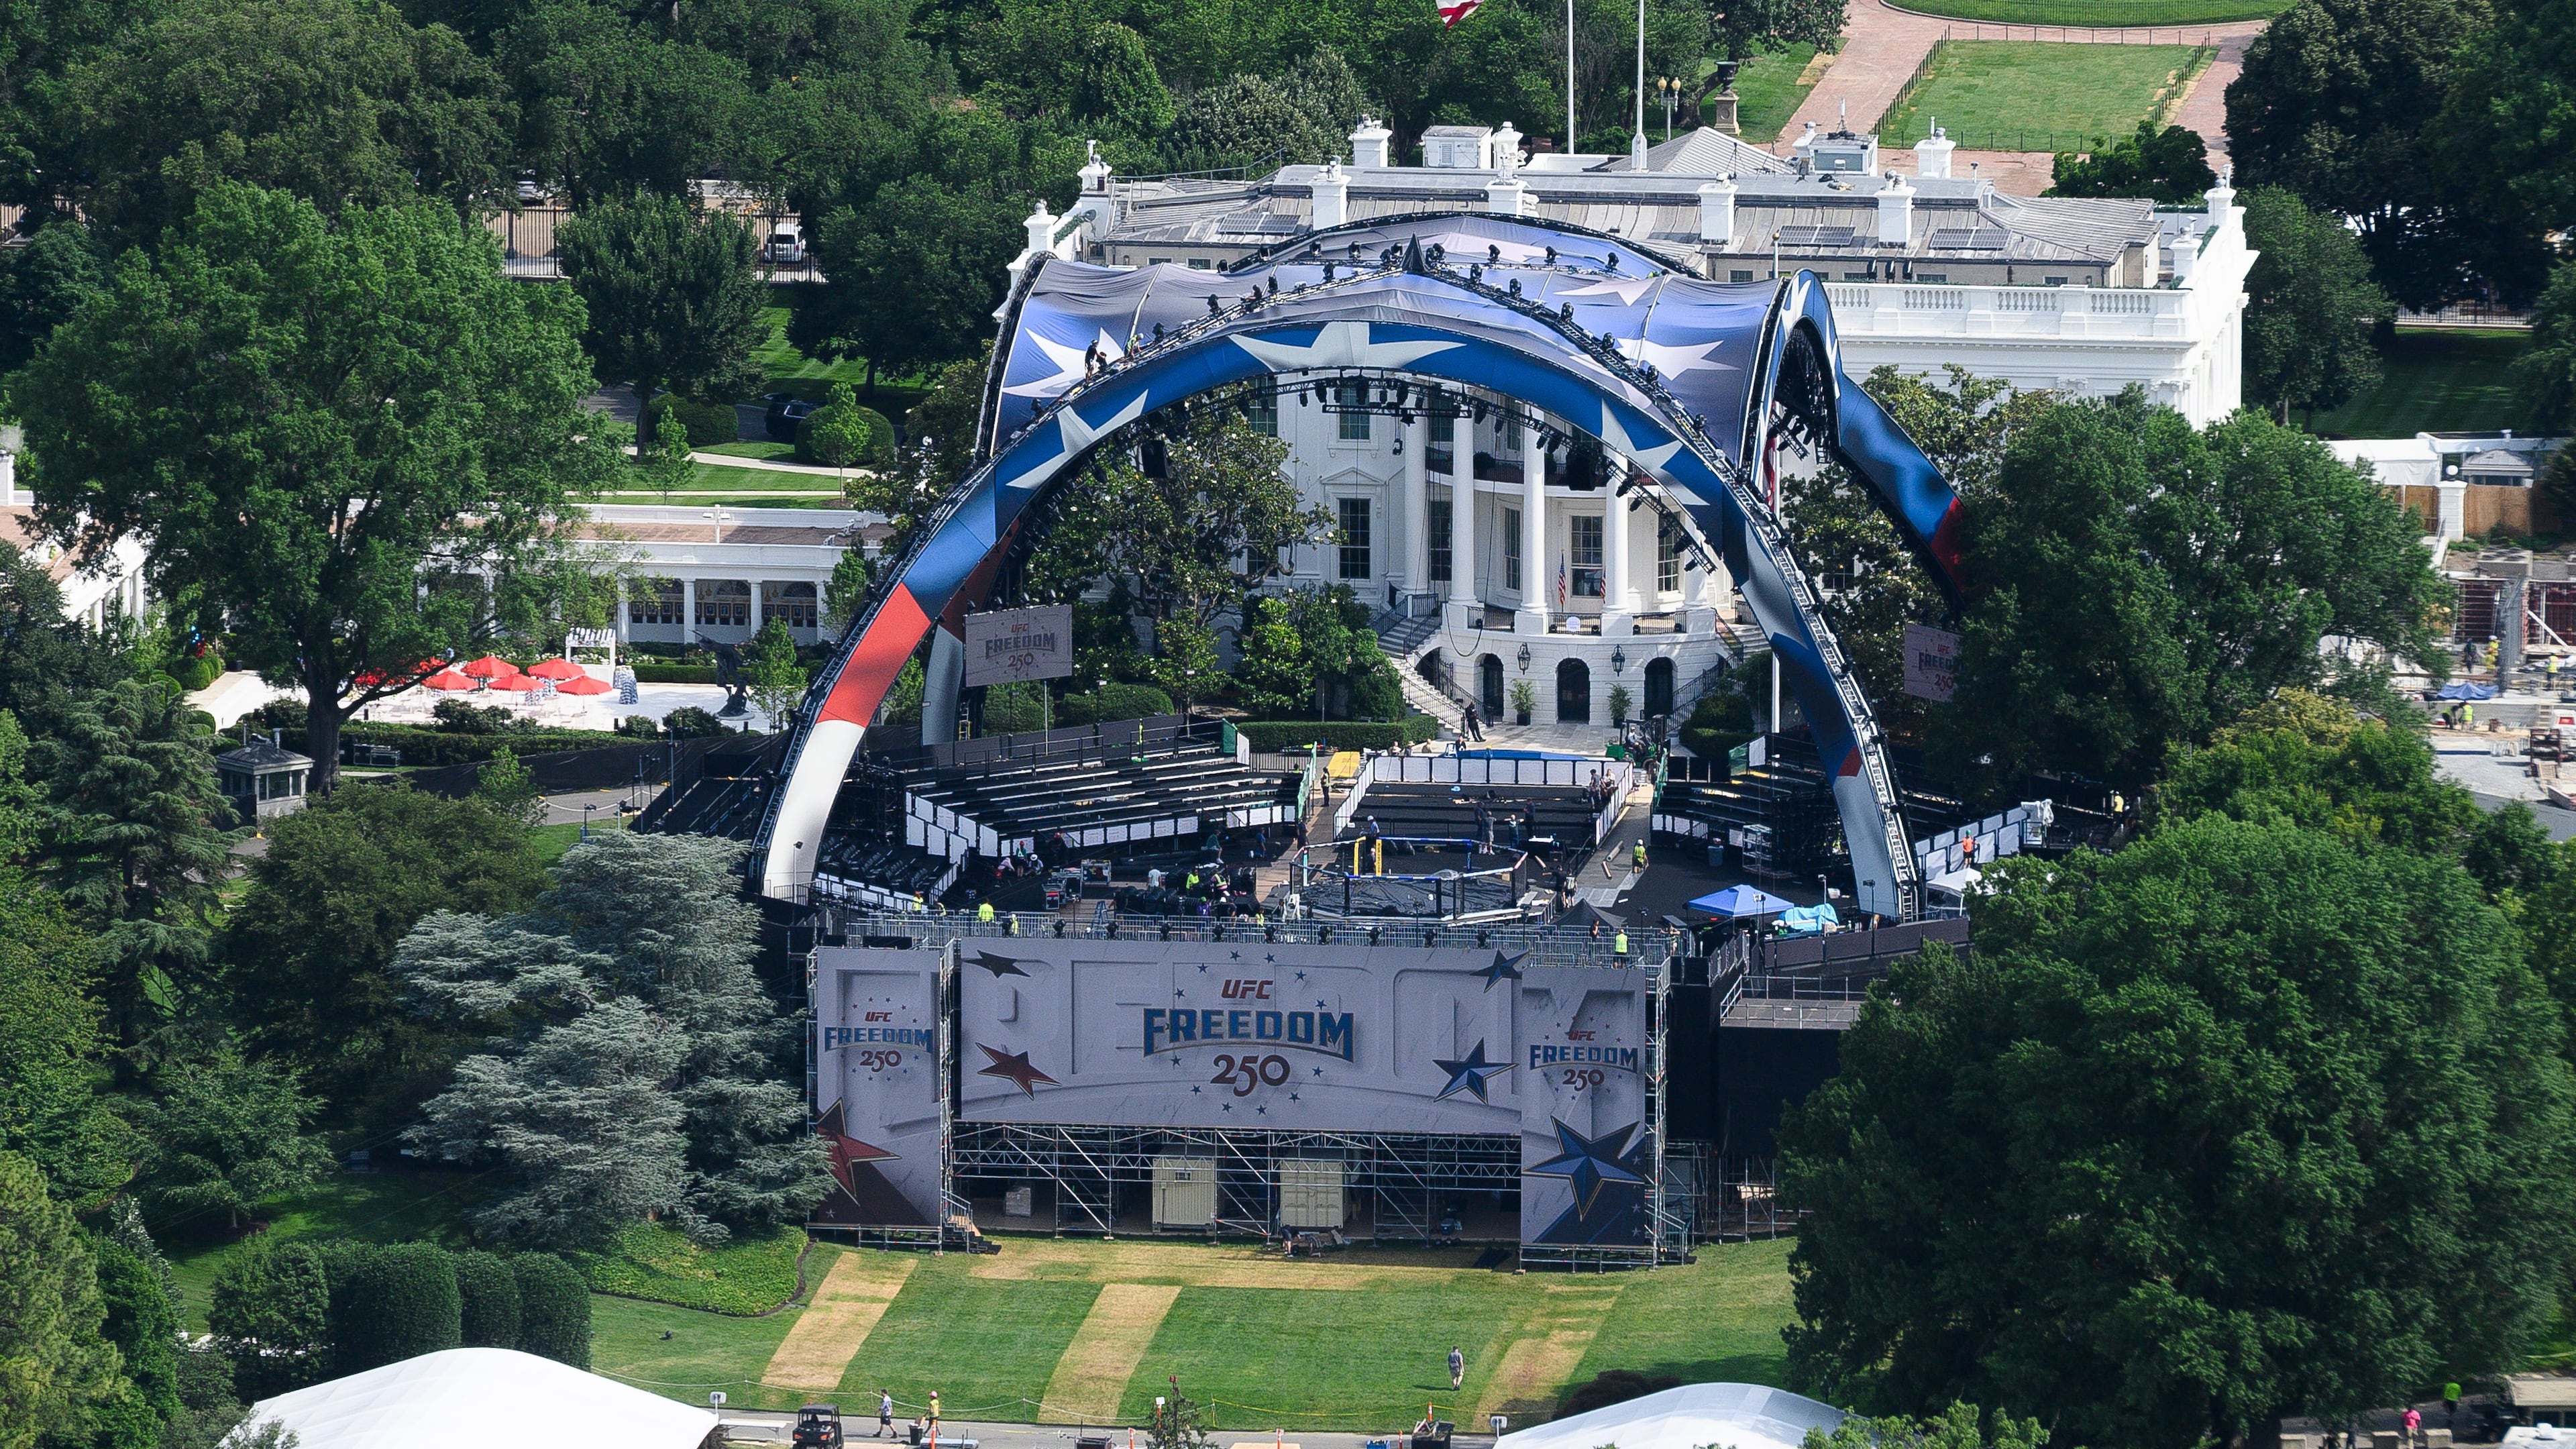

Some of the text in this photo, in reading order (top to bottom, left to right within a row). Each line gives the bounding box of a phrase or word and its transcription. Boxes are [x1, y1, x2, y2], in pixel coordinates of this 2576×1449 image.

[1011, 623, 1028, 633] UFC
[985, 632, 1055, 659] FREEDOM
[1937, 644, 1951, 654] UFC
[1008, 652, 1034, 671] 250
[1934, 673, 1953, 692] 250
[1221, 979, 1273, 1000] UFC
[865, 1012, 892, 1022] UFC
[824, 1026, 933, 1054] FREEDOM
[1143, 1008, 1354, 1063] FREEDOM
[1568, 1030, 1596, 1041] UFC
[859, 1049, 902, 1073] 250
[1529, 1044, 1639, 1074] FREEDOM
[1210, 1054, 1291, 1097] 250
[1562, 1068, 1605, 1092] 250
